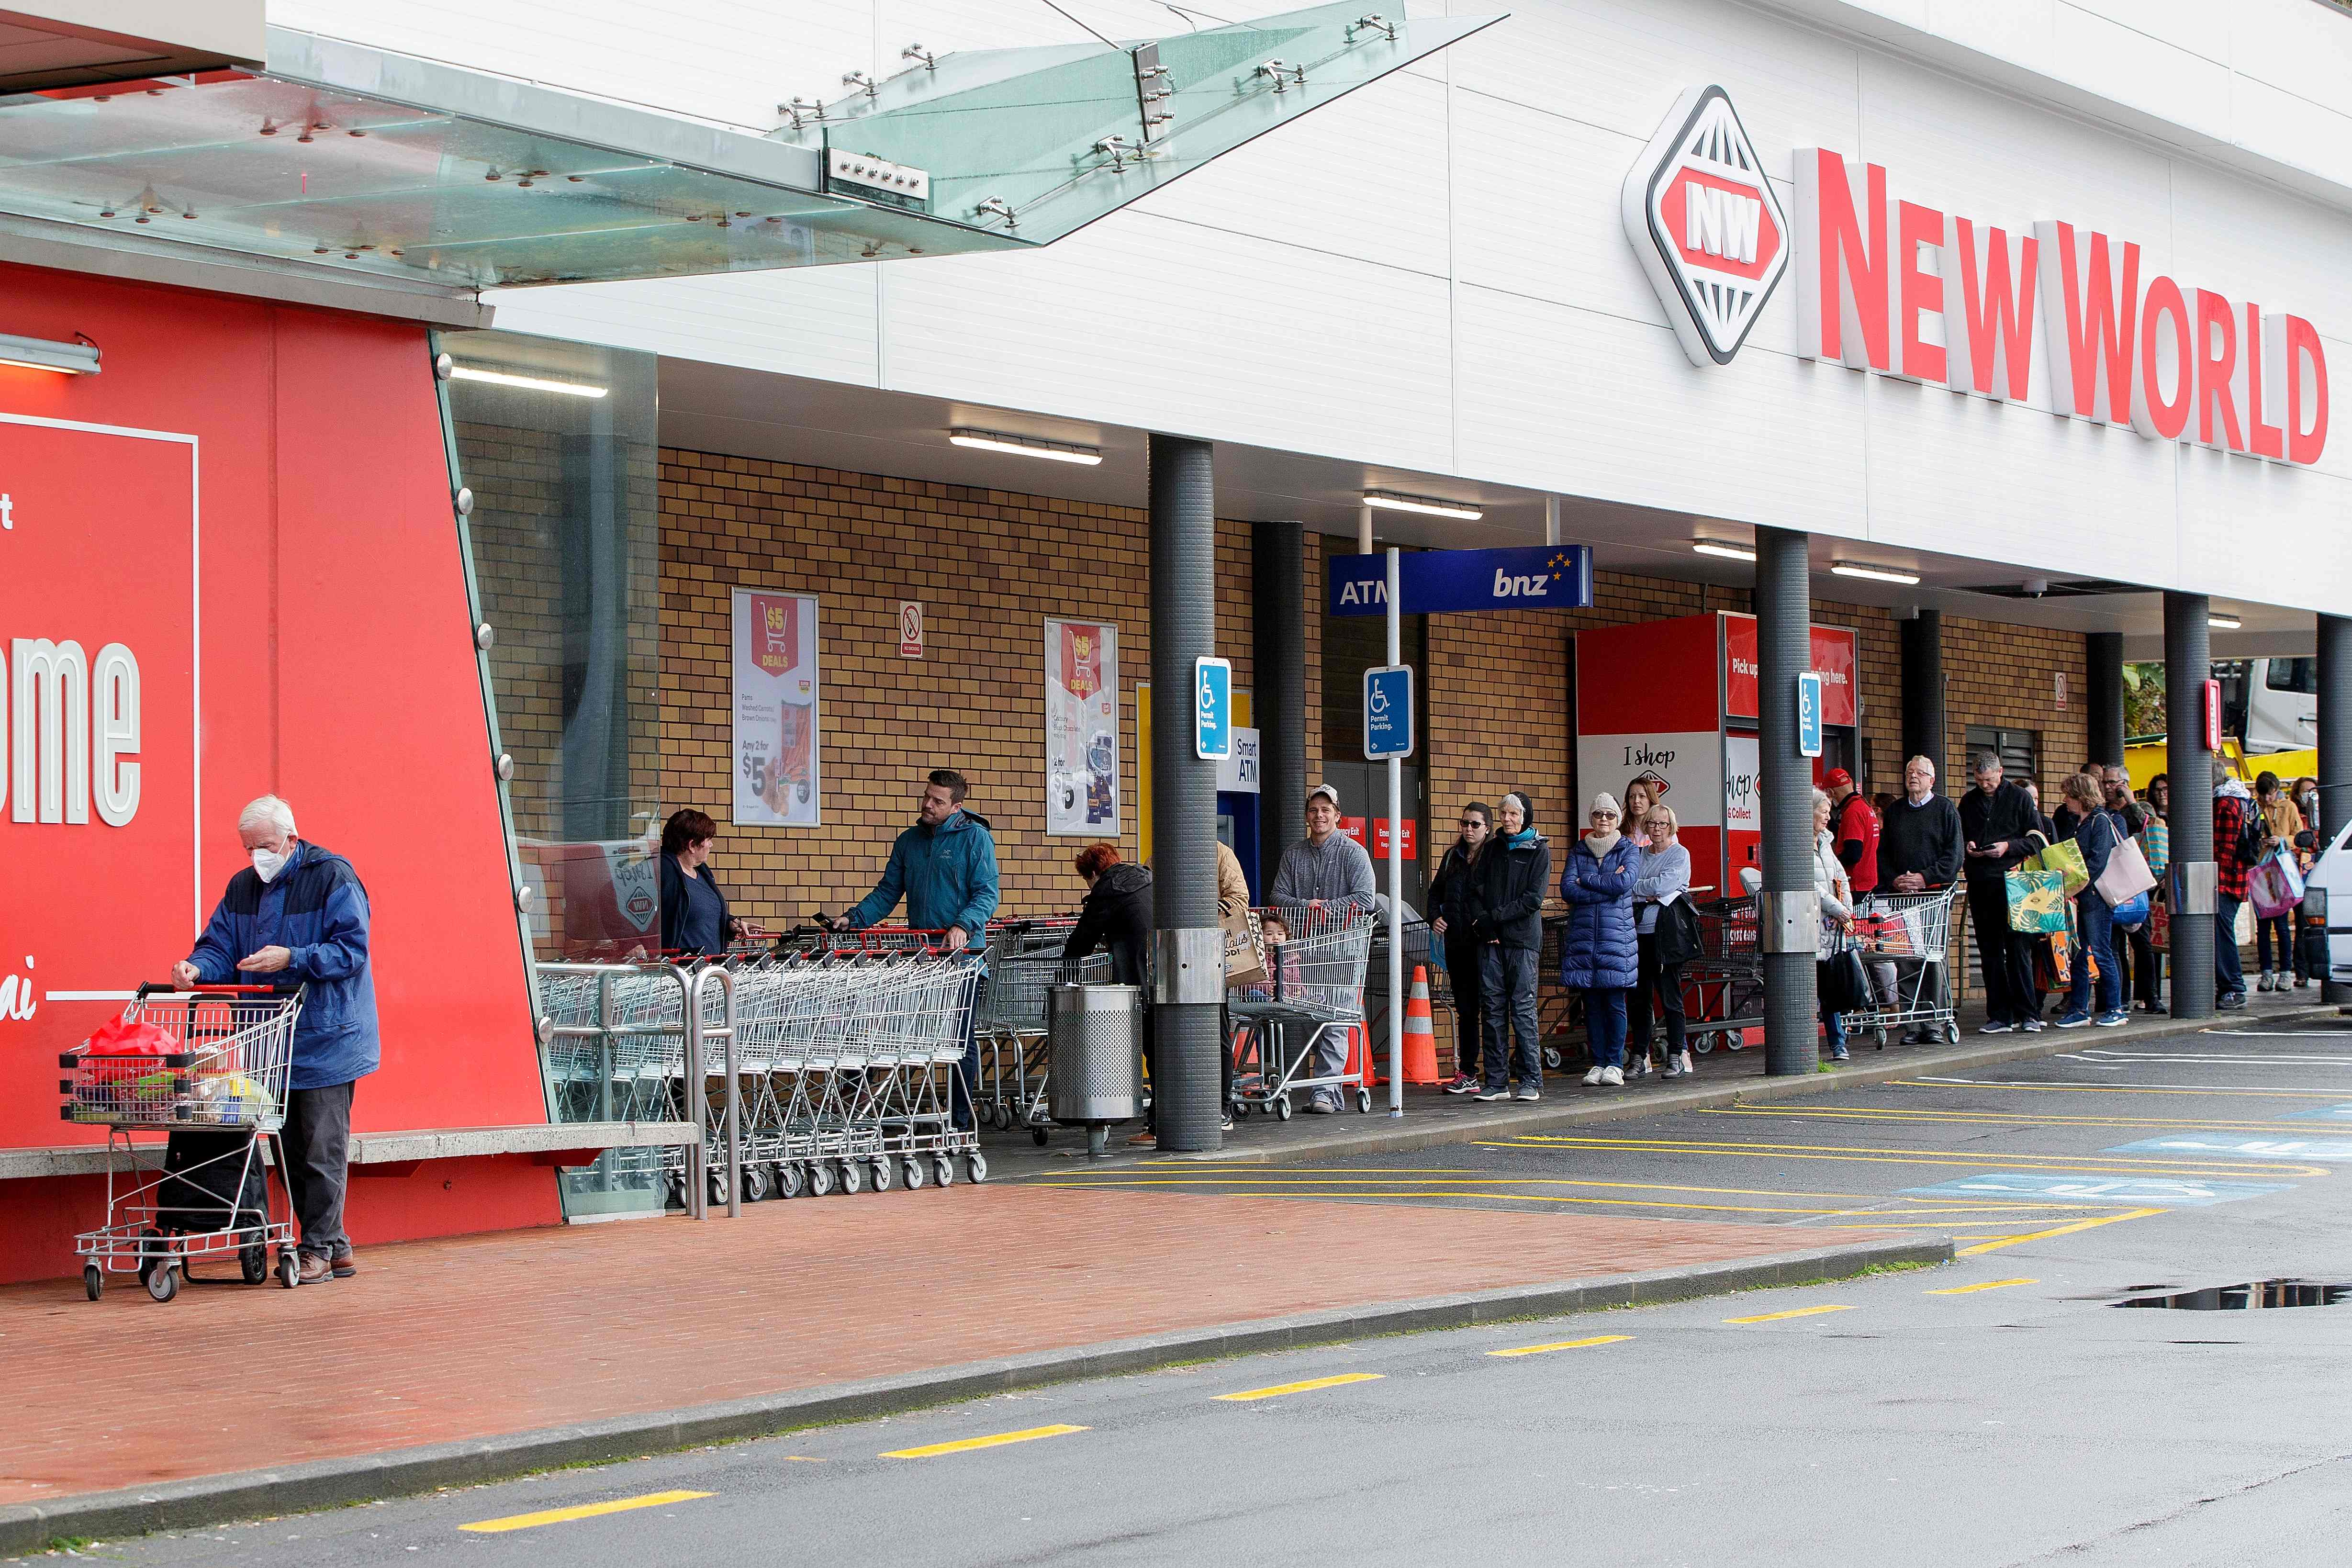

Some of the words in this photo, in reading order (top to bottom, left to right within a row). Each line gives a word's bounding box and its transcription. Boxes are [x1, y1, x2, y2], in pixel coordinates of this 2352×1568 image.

[1685, 180, 1761, 265] NW
[1804, 147, 2038, 402] NEW
[2045, 220, 2329, 464] WORLD
[1493, 568, 1549, 597] bnz
[767, 607, 784, 629] $5
[1075, 636, 1089, 656] $5
[762, 655, 788, 668] DEALS
[1733, 658, 1748, 674] Pick
[1831, 669, 1848, 684] here.
[1071, 680, 1093, 691] DEALS
[1371, 714, 1388, 722] Permit
[0, 638, 141, 827] me
[742, 740, 755, 752] Any
[756, 741, 759, 750] 2
[760, 740, 769, 750] for
[1237, 738, 1256, 757] Smart
[1054, 758, 1057, 766] 2
[1624, 746, 1632, 766] I
[1635, 743, 1675, 769] shop
[743, 752, 766, 796] $5
[1239, 759, 1257, 783] ATM
[1727, 807, 1731, 818] &
[1732, 807, 1751, 819] Collect
[1351, 827, 1359, 836] Exit
[1402, 829, 1410, 838] Exit
